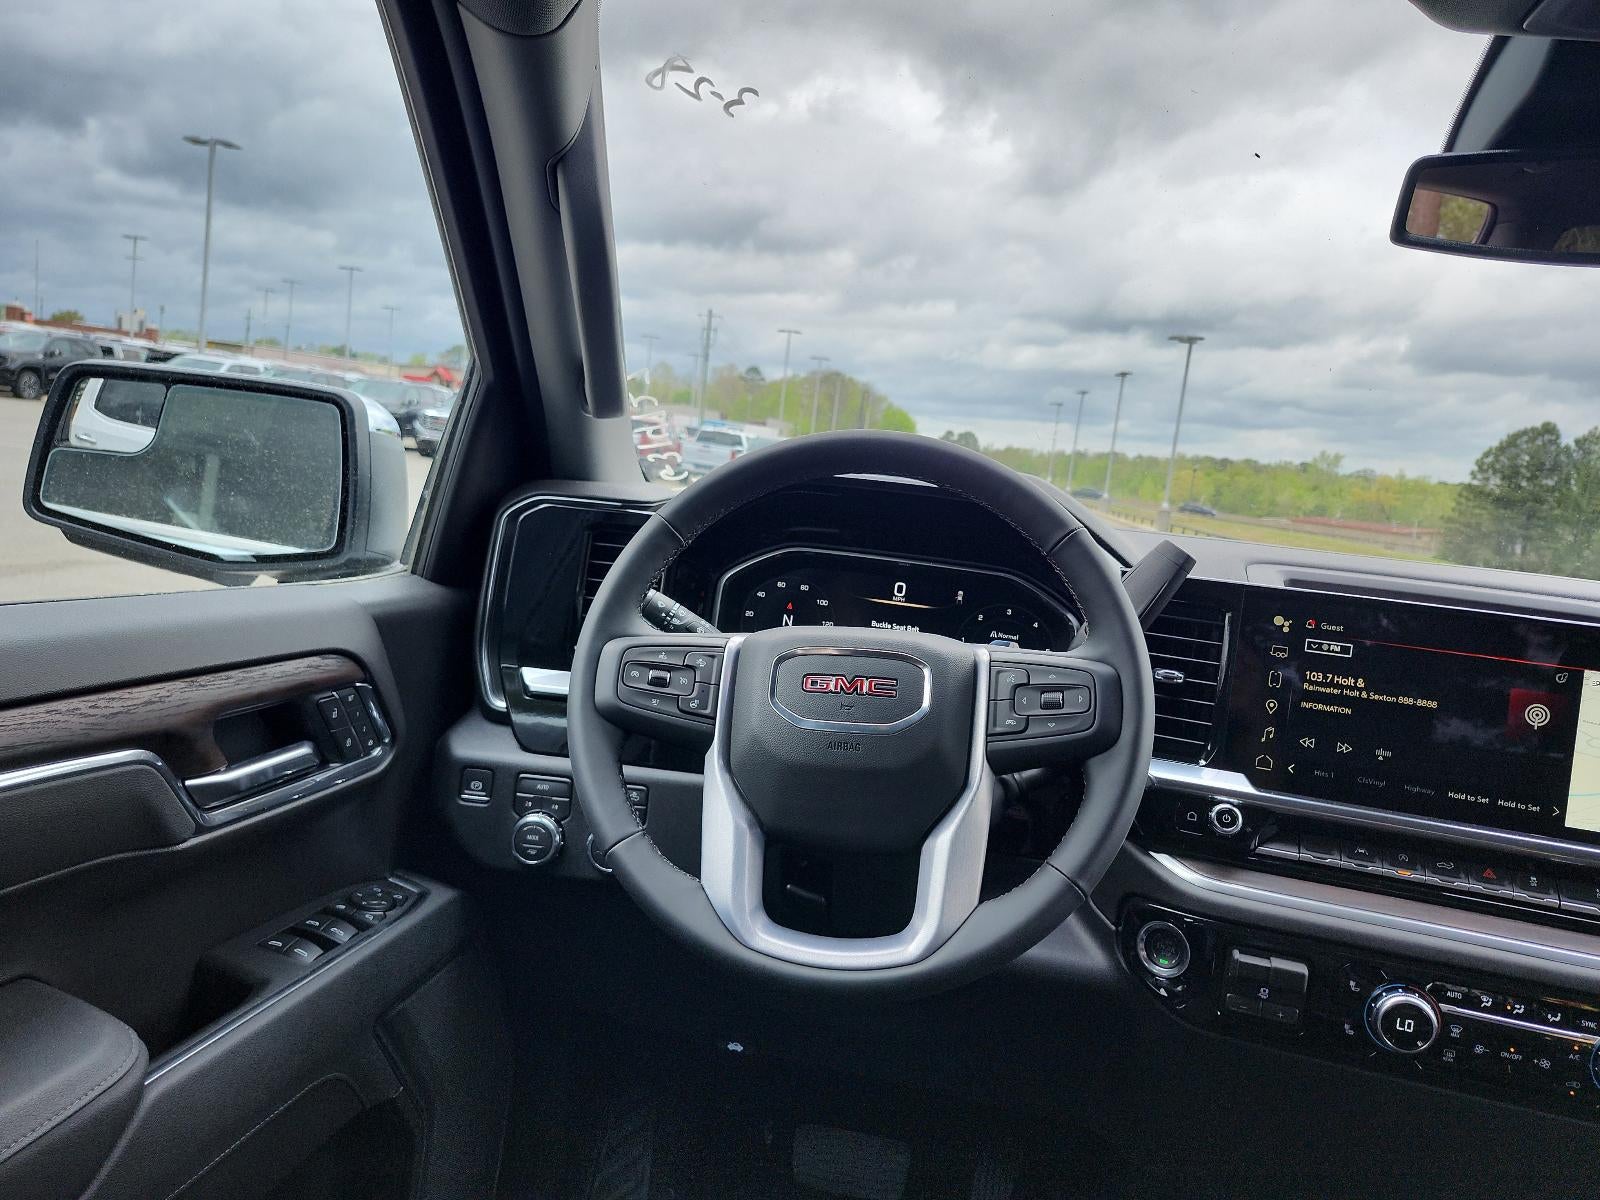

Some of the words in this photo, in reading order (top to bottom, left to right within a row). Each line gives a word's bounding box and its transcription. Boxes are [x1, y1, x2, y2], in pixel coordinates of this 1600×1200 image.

[782, 613, 794, 627] N
[871, 620, 892, 629] Buckle
[892, 623, 907, 631] Seat
[1321, 622, 1344, 632] Guest
[998, 632, 1020, 641] Normal
[1329, 643, 1341, 652] FM
[1305, 670, 1333, 683] 103.7
[1334, 675, 1355, 686] Holt
[1356, 678, 1365, 688] &
[803, 675, 897, 697] GMC
[1303, 682, 1342, 695] Rainwater
[1343, 688, 1360, 698] Holt
[1360, 690, 1368, 699] &
[1369, 692, 1397, 703] Sexton
[1397, 696, 1438, 709] 888-8888
[1300, 701, 1352, 715] INFORMATION
[827, 741, 861, 752] AIRBAG
[1314, 769, 1329, 778] Hits
[1404, 784, 1435, 796] Highway
[1448, 791, 1466, 801] Hold
[1467, 794, 1476, 802] to
[1477, 796, 1489, 804] Set
[1498, 799, 1516, 809] Hold
[1527, 804, 1540, 812] Set
[1446, 991, 1462, 1000] AUTO
[1581, 1020, 1598, 1030] SYNC
[1500, 1052, 1522, 1061] ON/OFF
[1568, 1053, 1581, 1061] A/C
